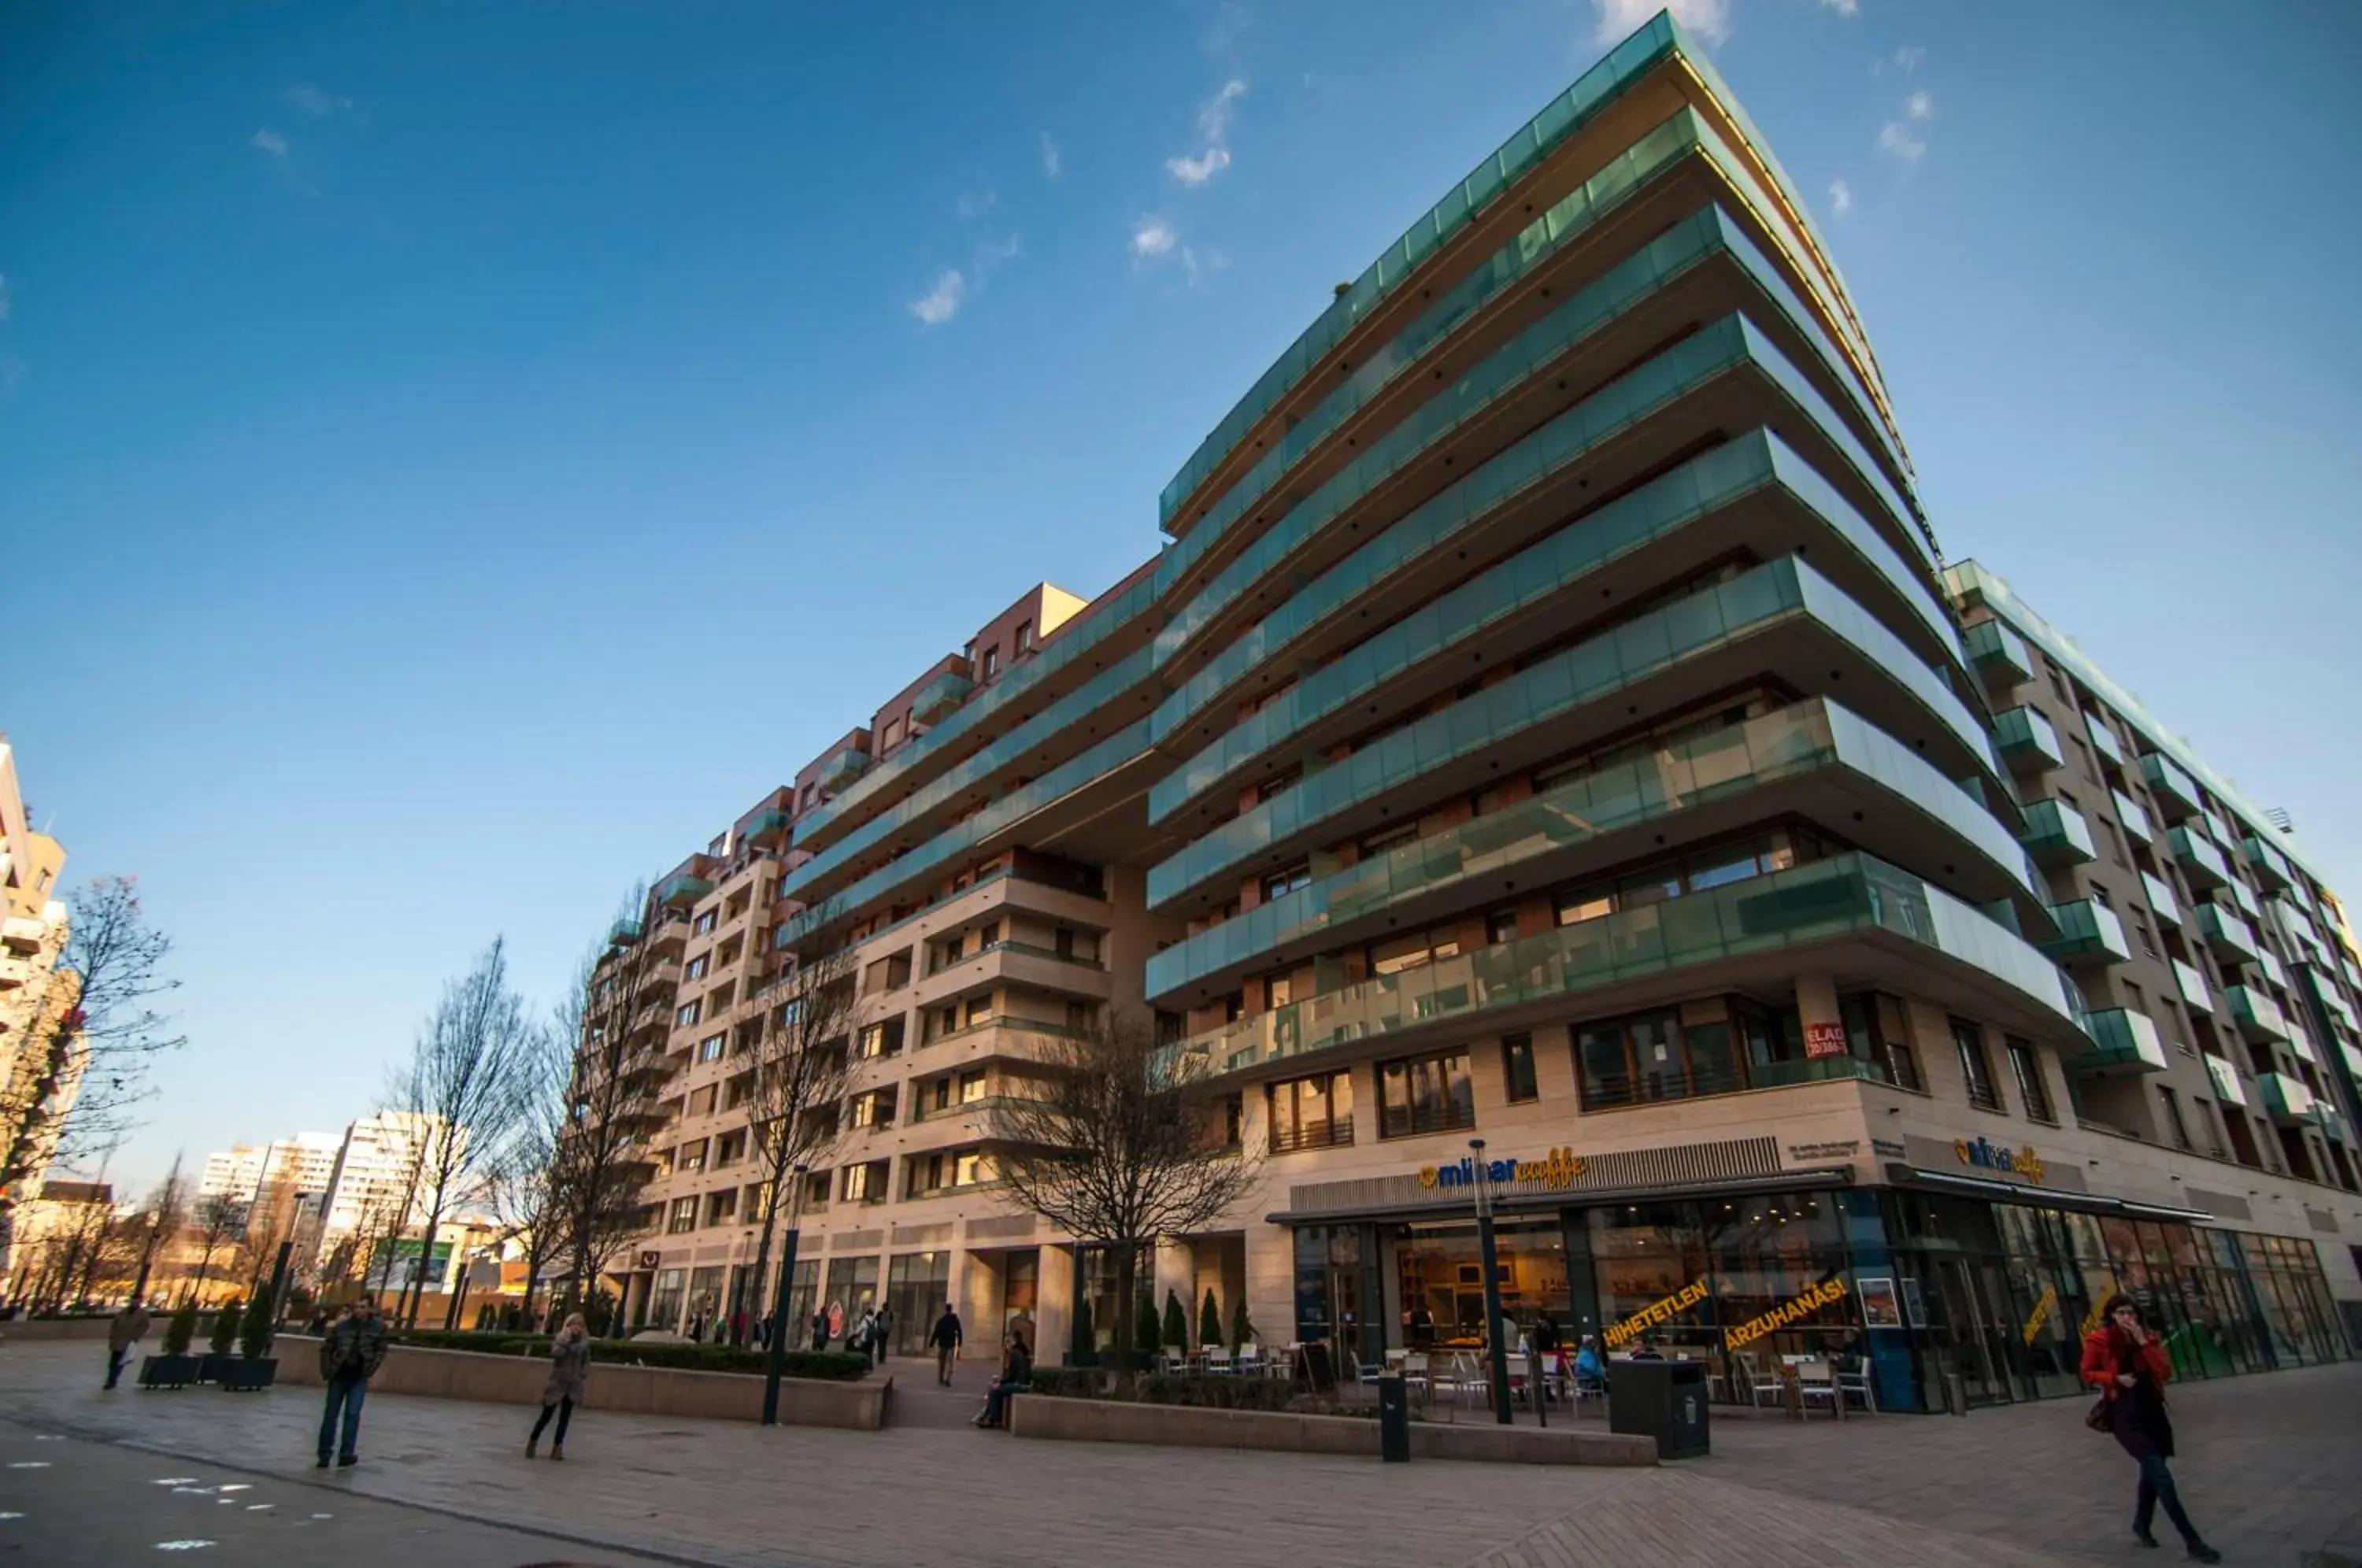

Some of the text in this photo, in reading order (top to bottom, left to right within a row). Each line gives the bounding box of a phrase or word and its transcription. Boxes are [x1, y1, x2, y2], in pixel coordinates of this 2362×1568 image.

[1438, 1156, 1518, 1185] mliar
[1603, 1277, 1847, 1351] HIHETETLEN ÁRZUHANÁS!
